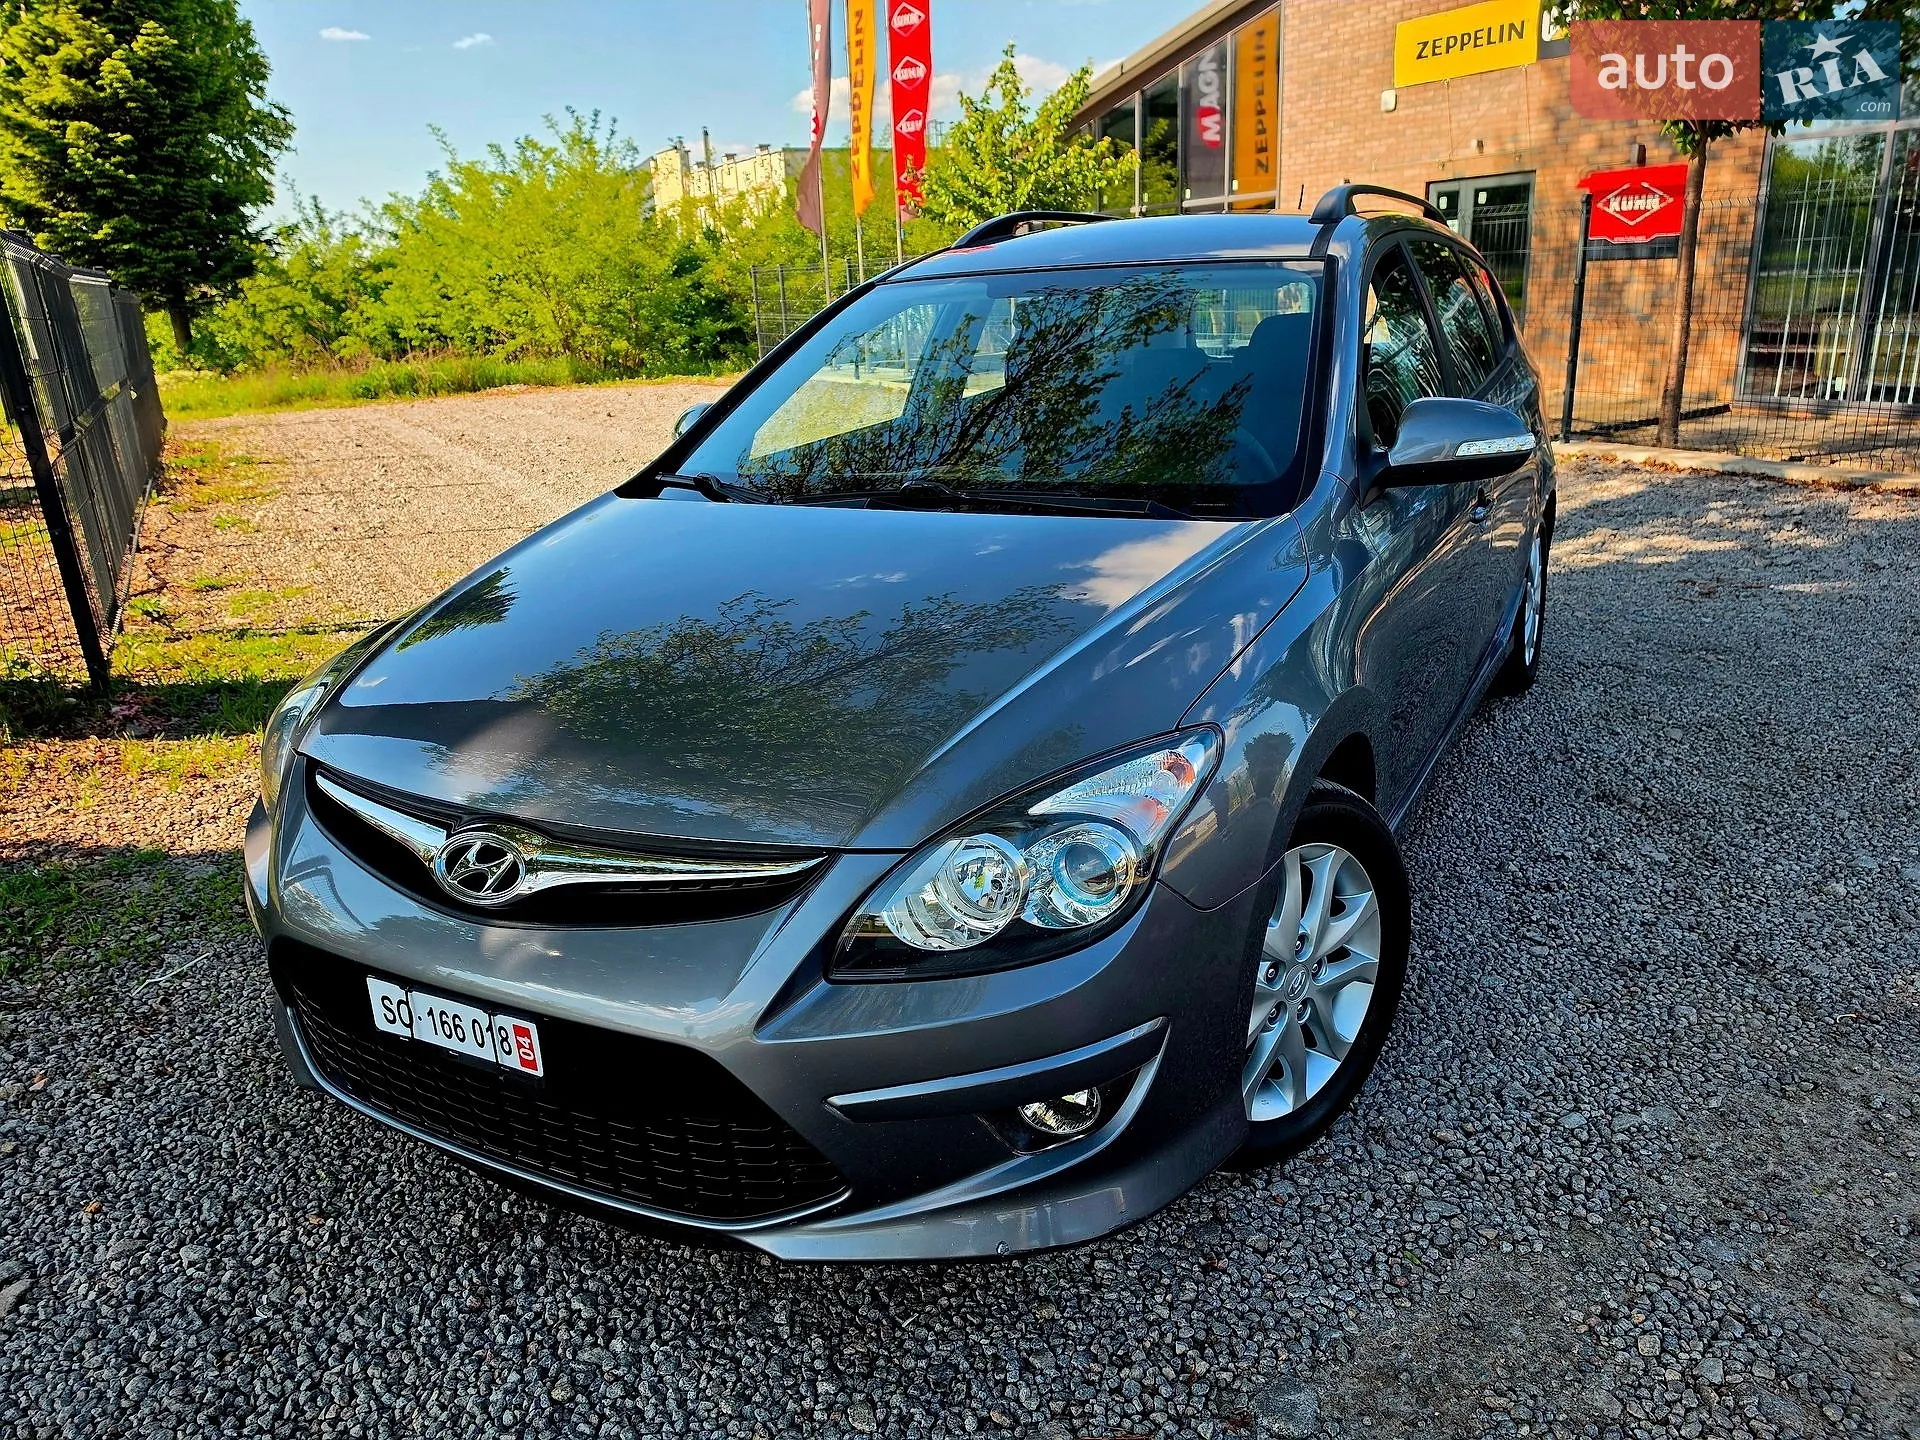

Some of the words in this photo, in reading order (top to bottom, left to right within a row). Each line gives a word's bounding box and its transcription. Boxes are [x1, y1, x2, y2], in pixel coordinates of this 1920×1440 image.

[1416, 20, 1525, 60] ZEPPELIN
[1609, 194, 1661, 211] KUHN
[427, 1006, 466, 1043] 166
[471, 1018, 513, 1056] 018
[516, 1036, 535, 1060] 04
